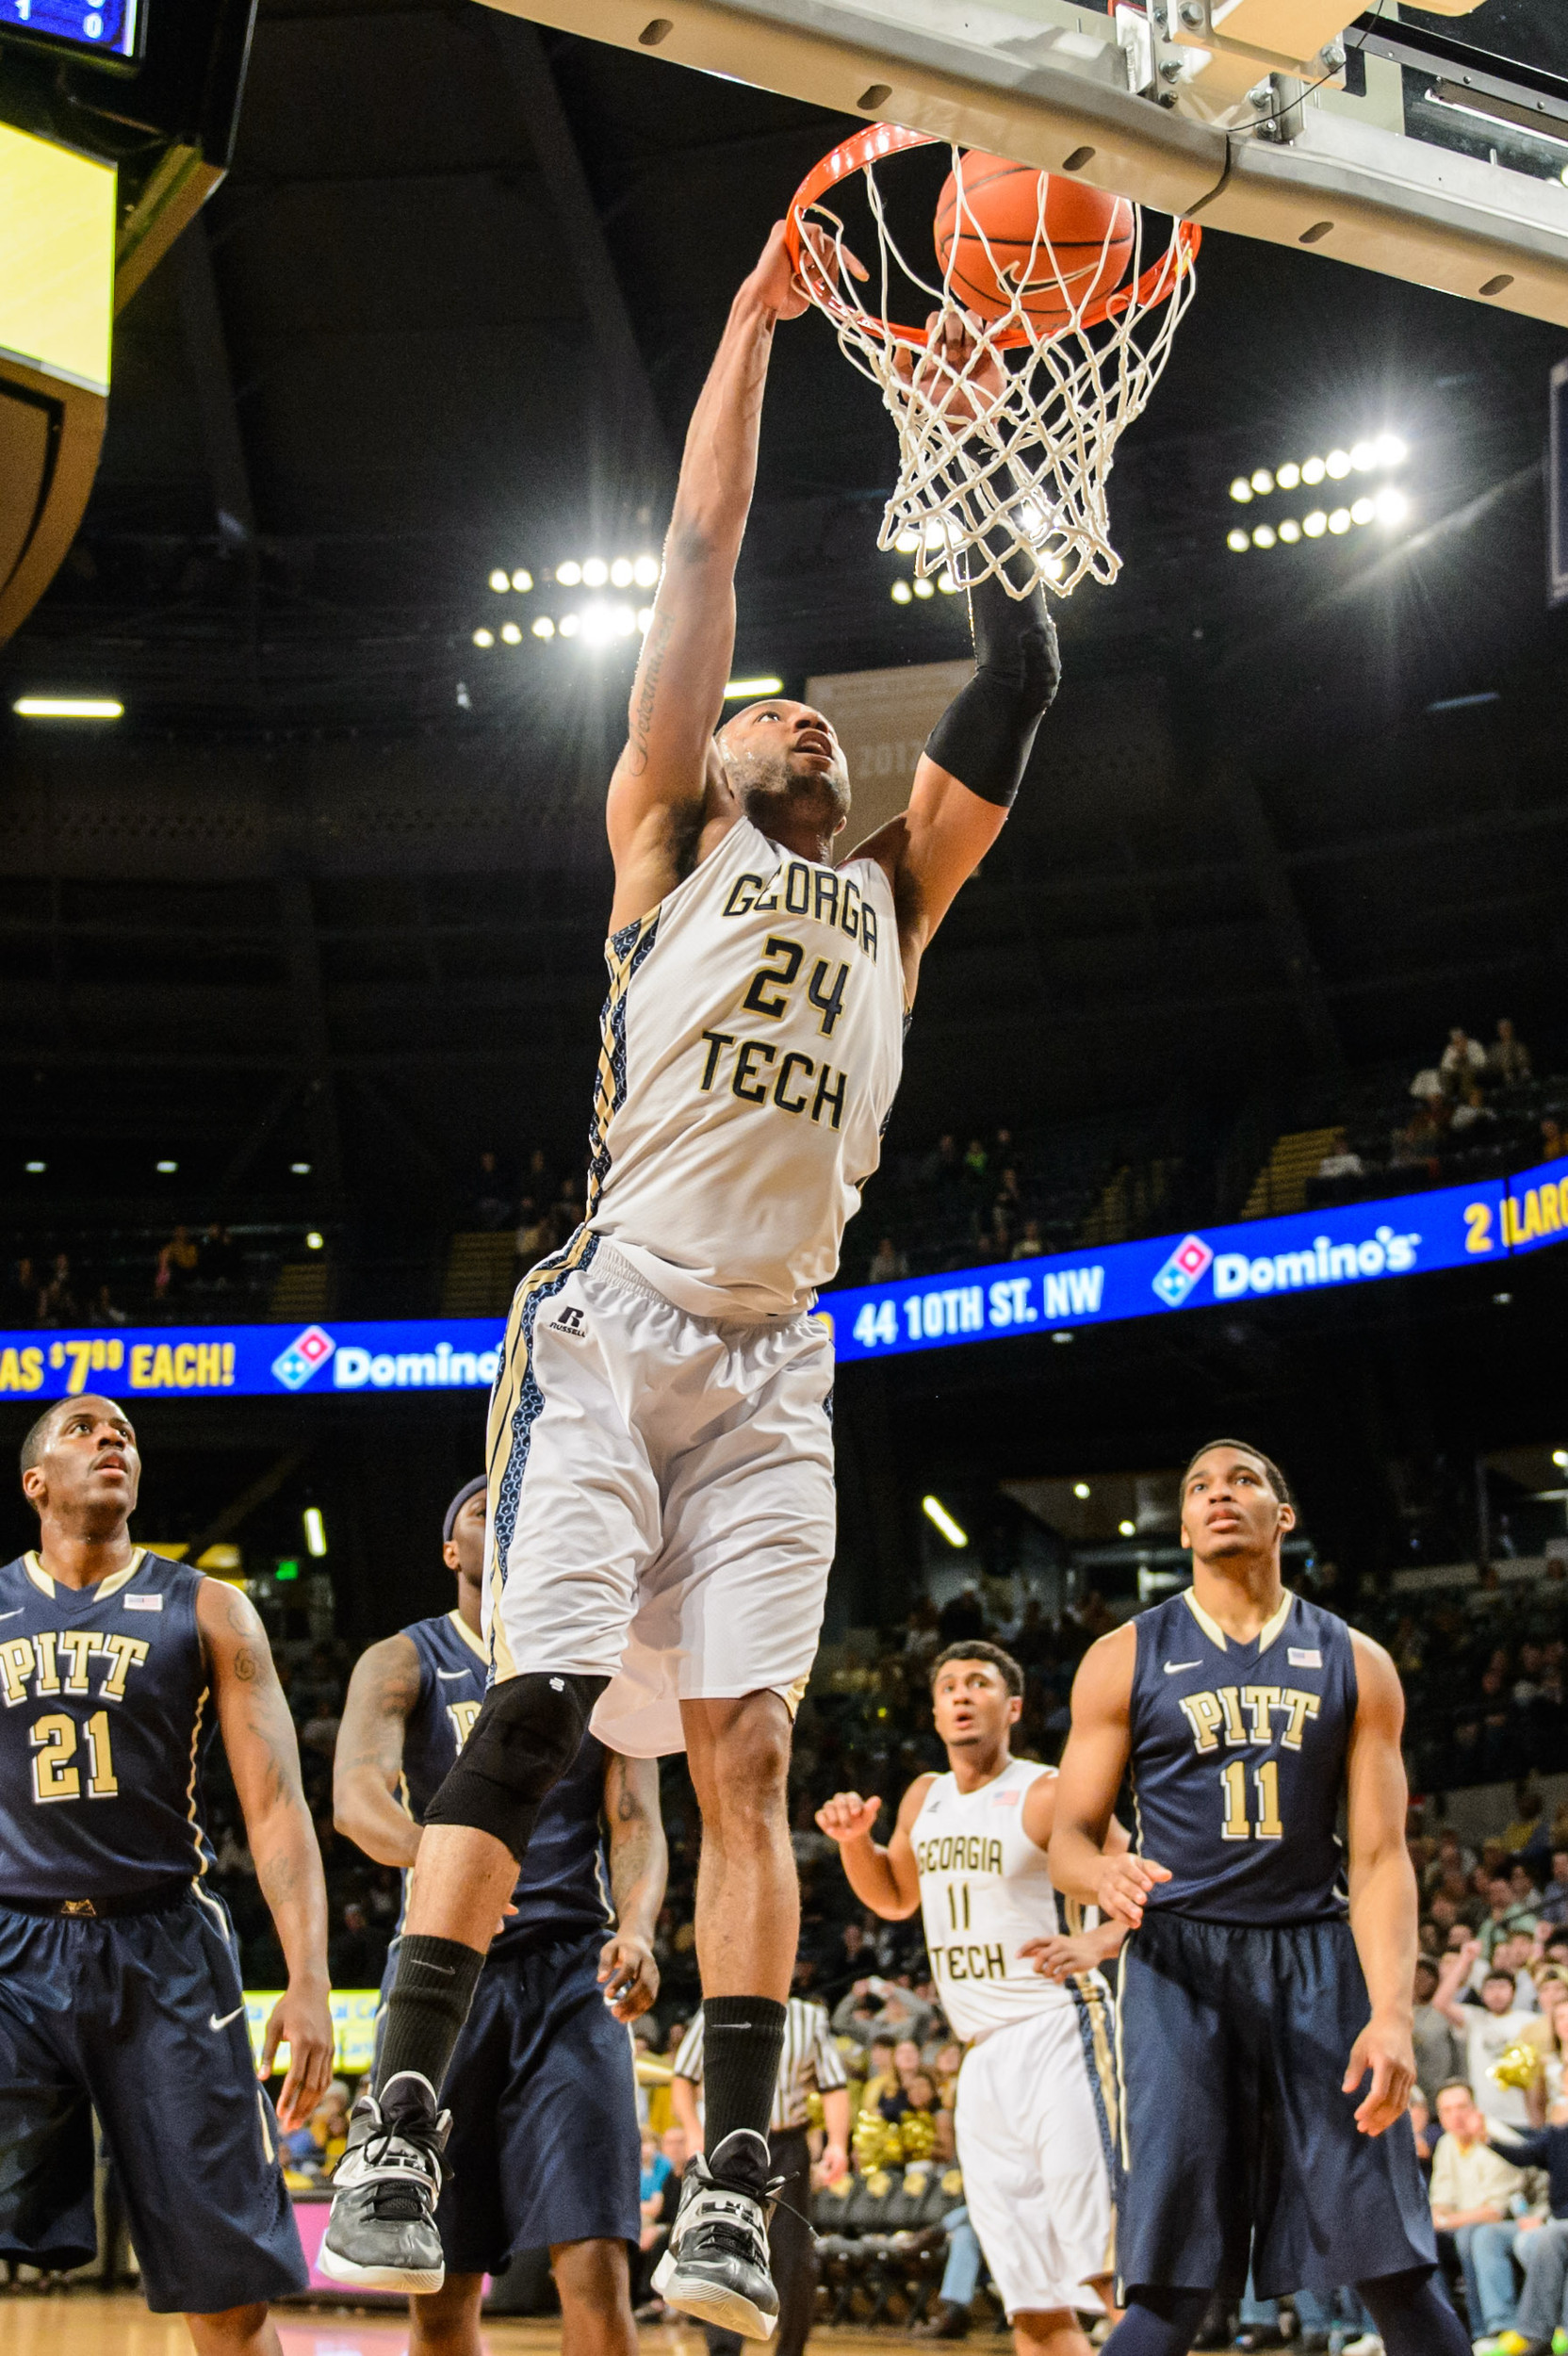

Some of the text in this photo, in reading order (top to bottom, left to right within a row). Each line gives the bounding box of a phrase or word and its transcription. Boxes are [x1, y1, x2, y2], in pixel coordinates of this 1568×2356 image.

[722, 859, 878, 966] GEORGA
[739, 934, 852, 1039] 24
[697, 1027, 848, 1132] TECH
[1213, 1225, 1417, 1300] Domino's
[1463, 1202, 1493, 1253] 2
[549, 1321, 585, 1338] RUSSELL
[853, 1301, 898, 1348] 44
[904, 1285, 984, 1340] 10TH
[989, 1277, 1037, 1327] ST.
[1043, 1265, 1104, 1319] NW
[130, 1342, 235, 1389] EACH!
[1, 1630, 150, 1708] PITT
[29, 1710, 119, 1804] 21
[1178, 1685, 1321, 1755] PITT
[1219, 1759, 1283, 1841] 11
[917, 1835, 1004, 1877] GEORGIA
[947, 1882, 971, 1930] 11
[930, 1943, 1005, 1983] TECH
